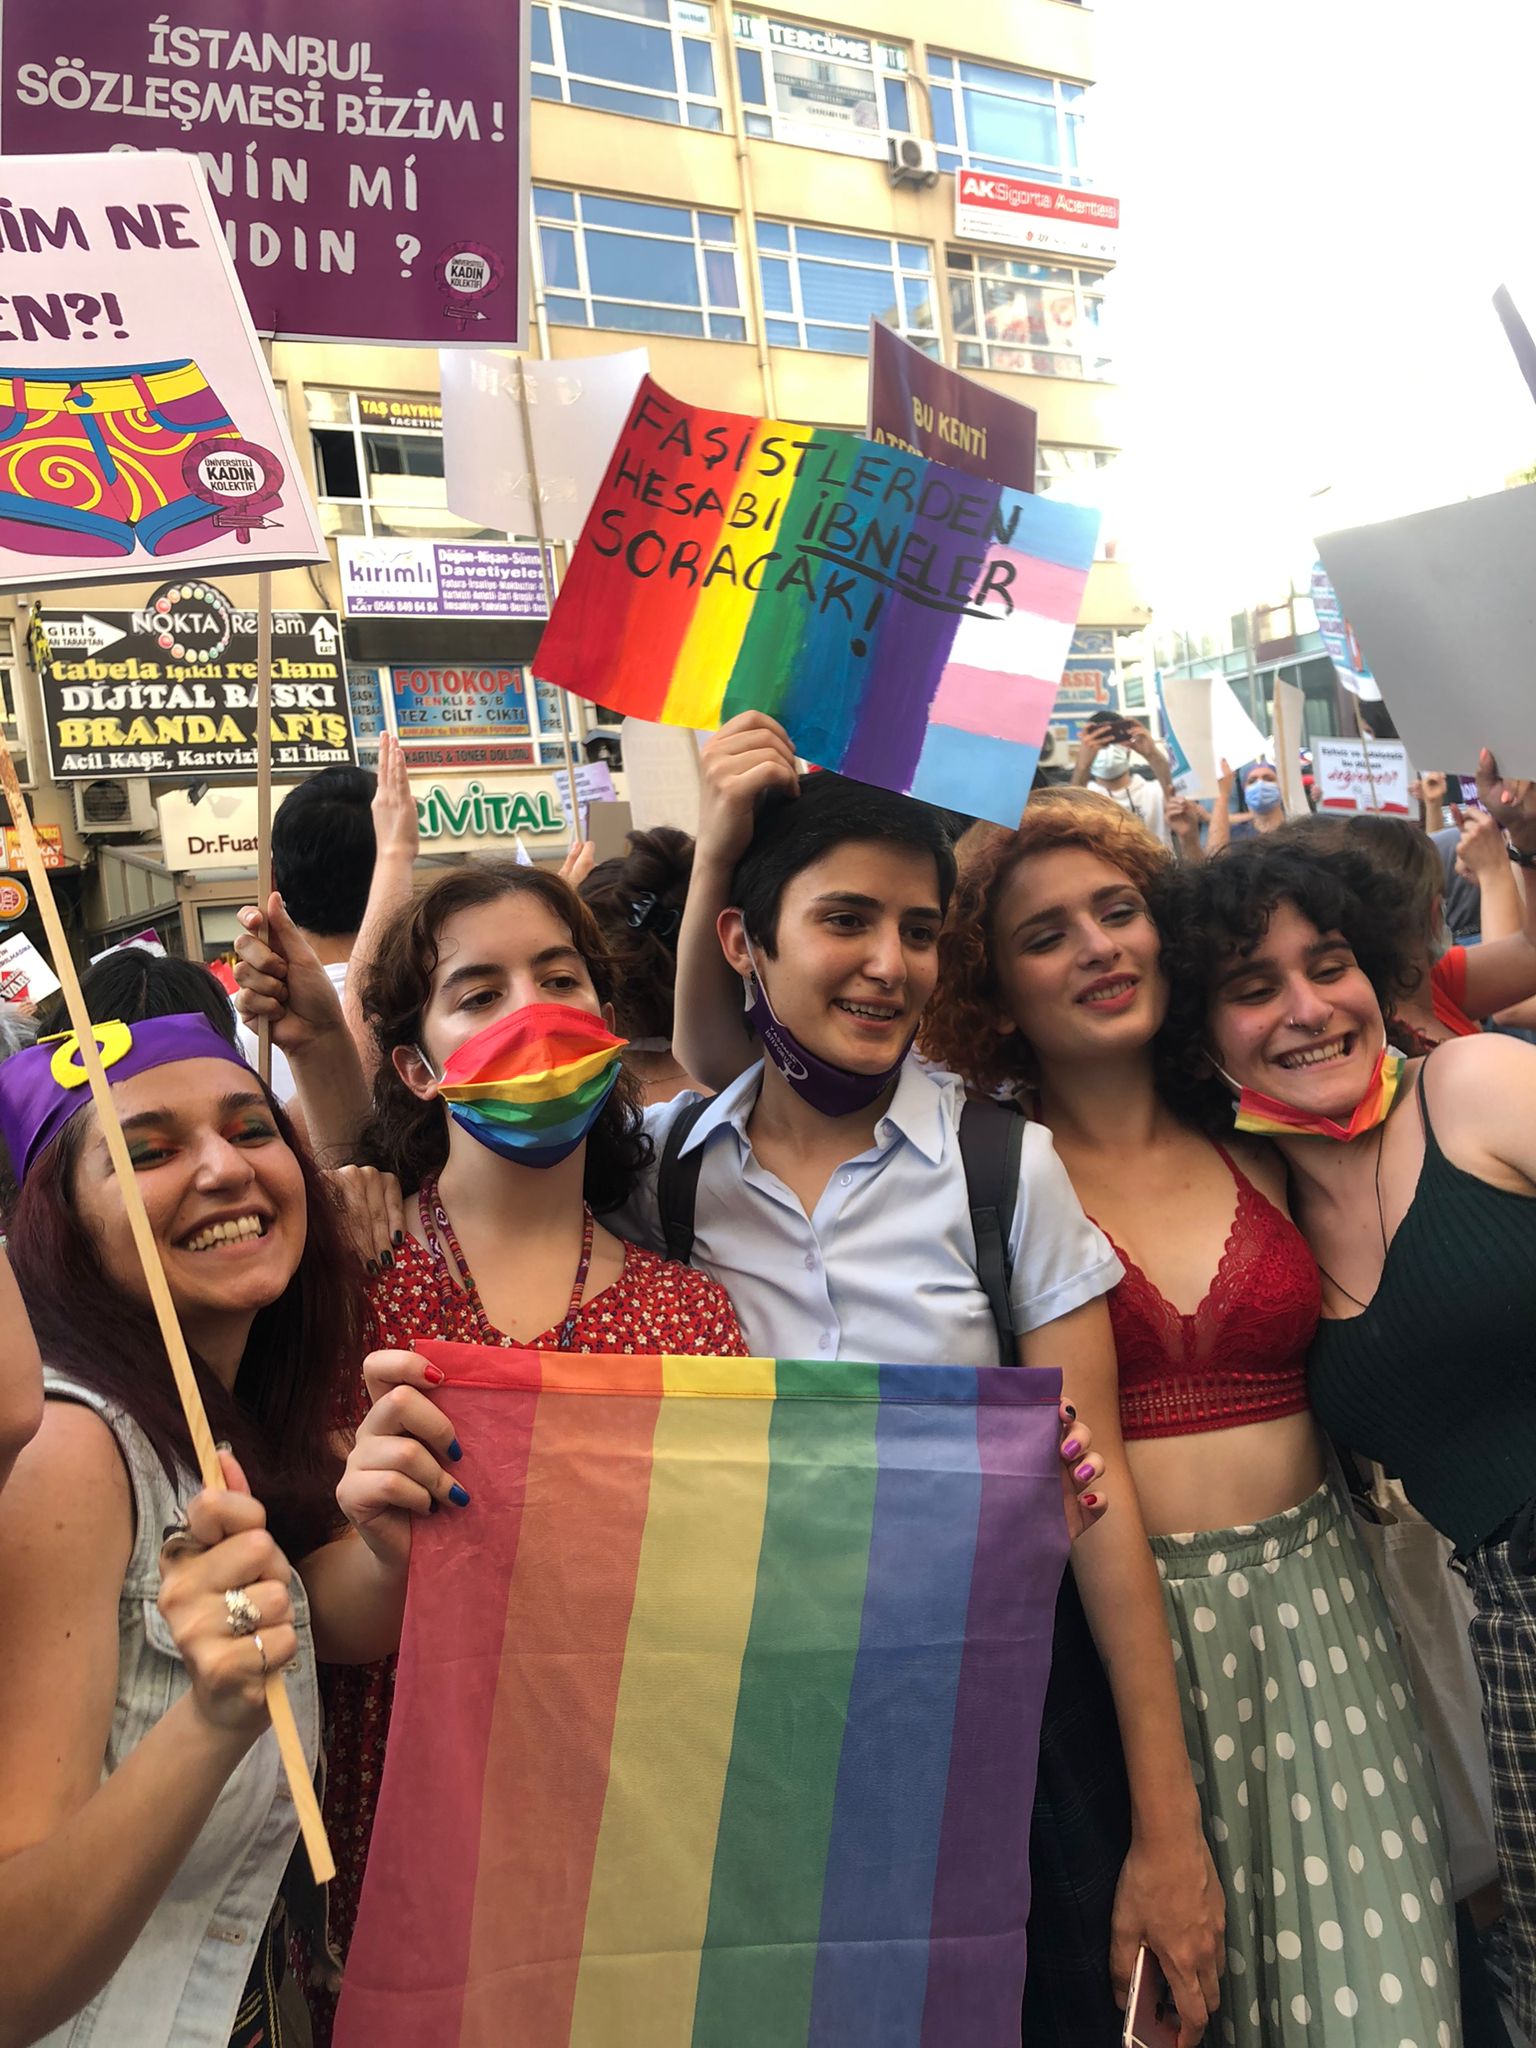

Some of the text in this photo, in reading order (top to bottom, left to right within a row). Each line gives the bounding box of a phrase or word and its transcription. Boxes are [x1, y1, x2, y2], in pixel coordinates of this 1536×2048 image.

[148, 14, 383, 83] İSTANBUL
[16, 56, 325, 132] SÖZLEŞMESİ
[349, 153, 418, 212] Mİ
[0, 197, 200, 253] İM NE
[395, 233, 422, 278] ?
[450, 265, 484, 280] KADIN
[360, 400, 389, 418] TAŞ
[912, 396, 935, 433] BU
[938, 411, 987, 461] KENTİ
[206, 467, 256, 481] KADIN
[631, 394, 1023, 546] FAŞİSTLERDEN
[210, 480, 257, 491] KOLEKTİFİ
[614, 449, 782, 531] HESABI
[797, 490, 1016, 617] İBNELER
[132, 612, 220, 636] NOKTA
[231, 613, 306, 635] Relam
[50, 657, 160, 682] tabela
[394, 669, 523, 694] FOTOKOPİ
[60, 680, 216, 712] DİJİTAL
[415, 695, 463, 706] RENKLİ
[466, 697, 475, 706] &
[401, 711, 428, 722] TEZ
[442, 709, 473, 722] CİLT
[56, 714, 248, 748] BRANDA
[61, 753, 104, 771] Acil
[108, 750, 174, 772] KAŞE,
[177, 748, 276, 768] Kartvizi,
[278, 745, 300, 763] El
